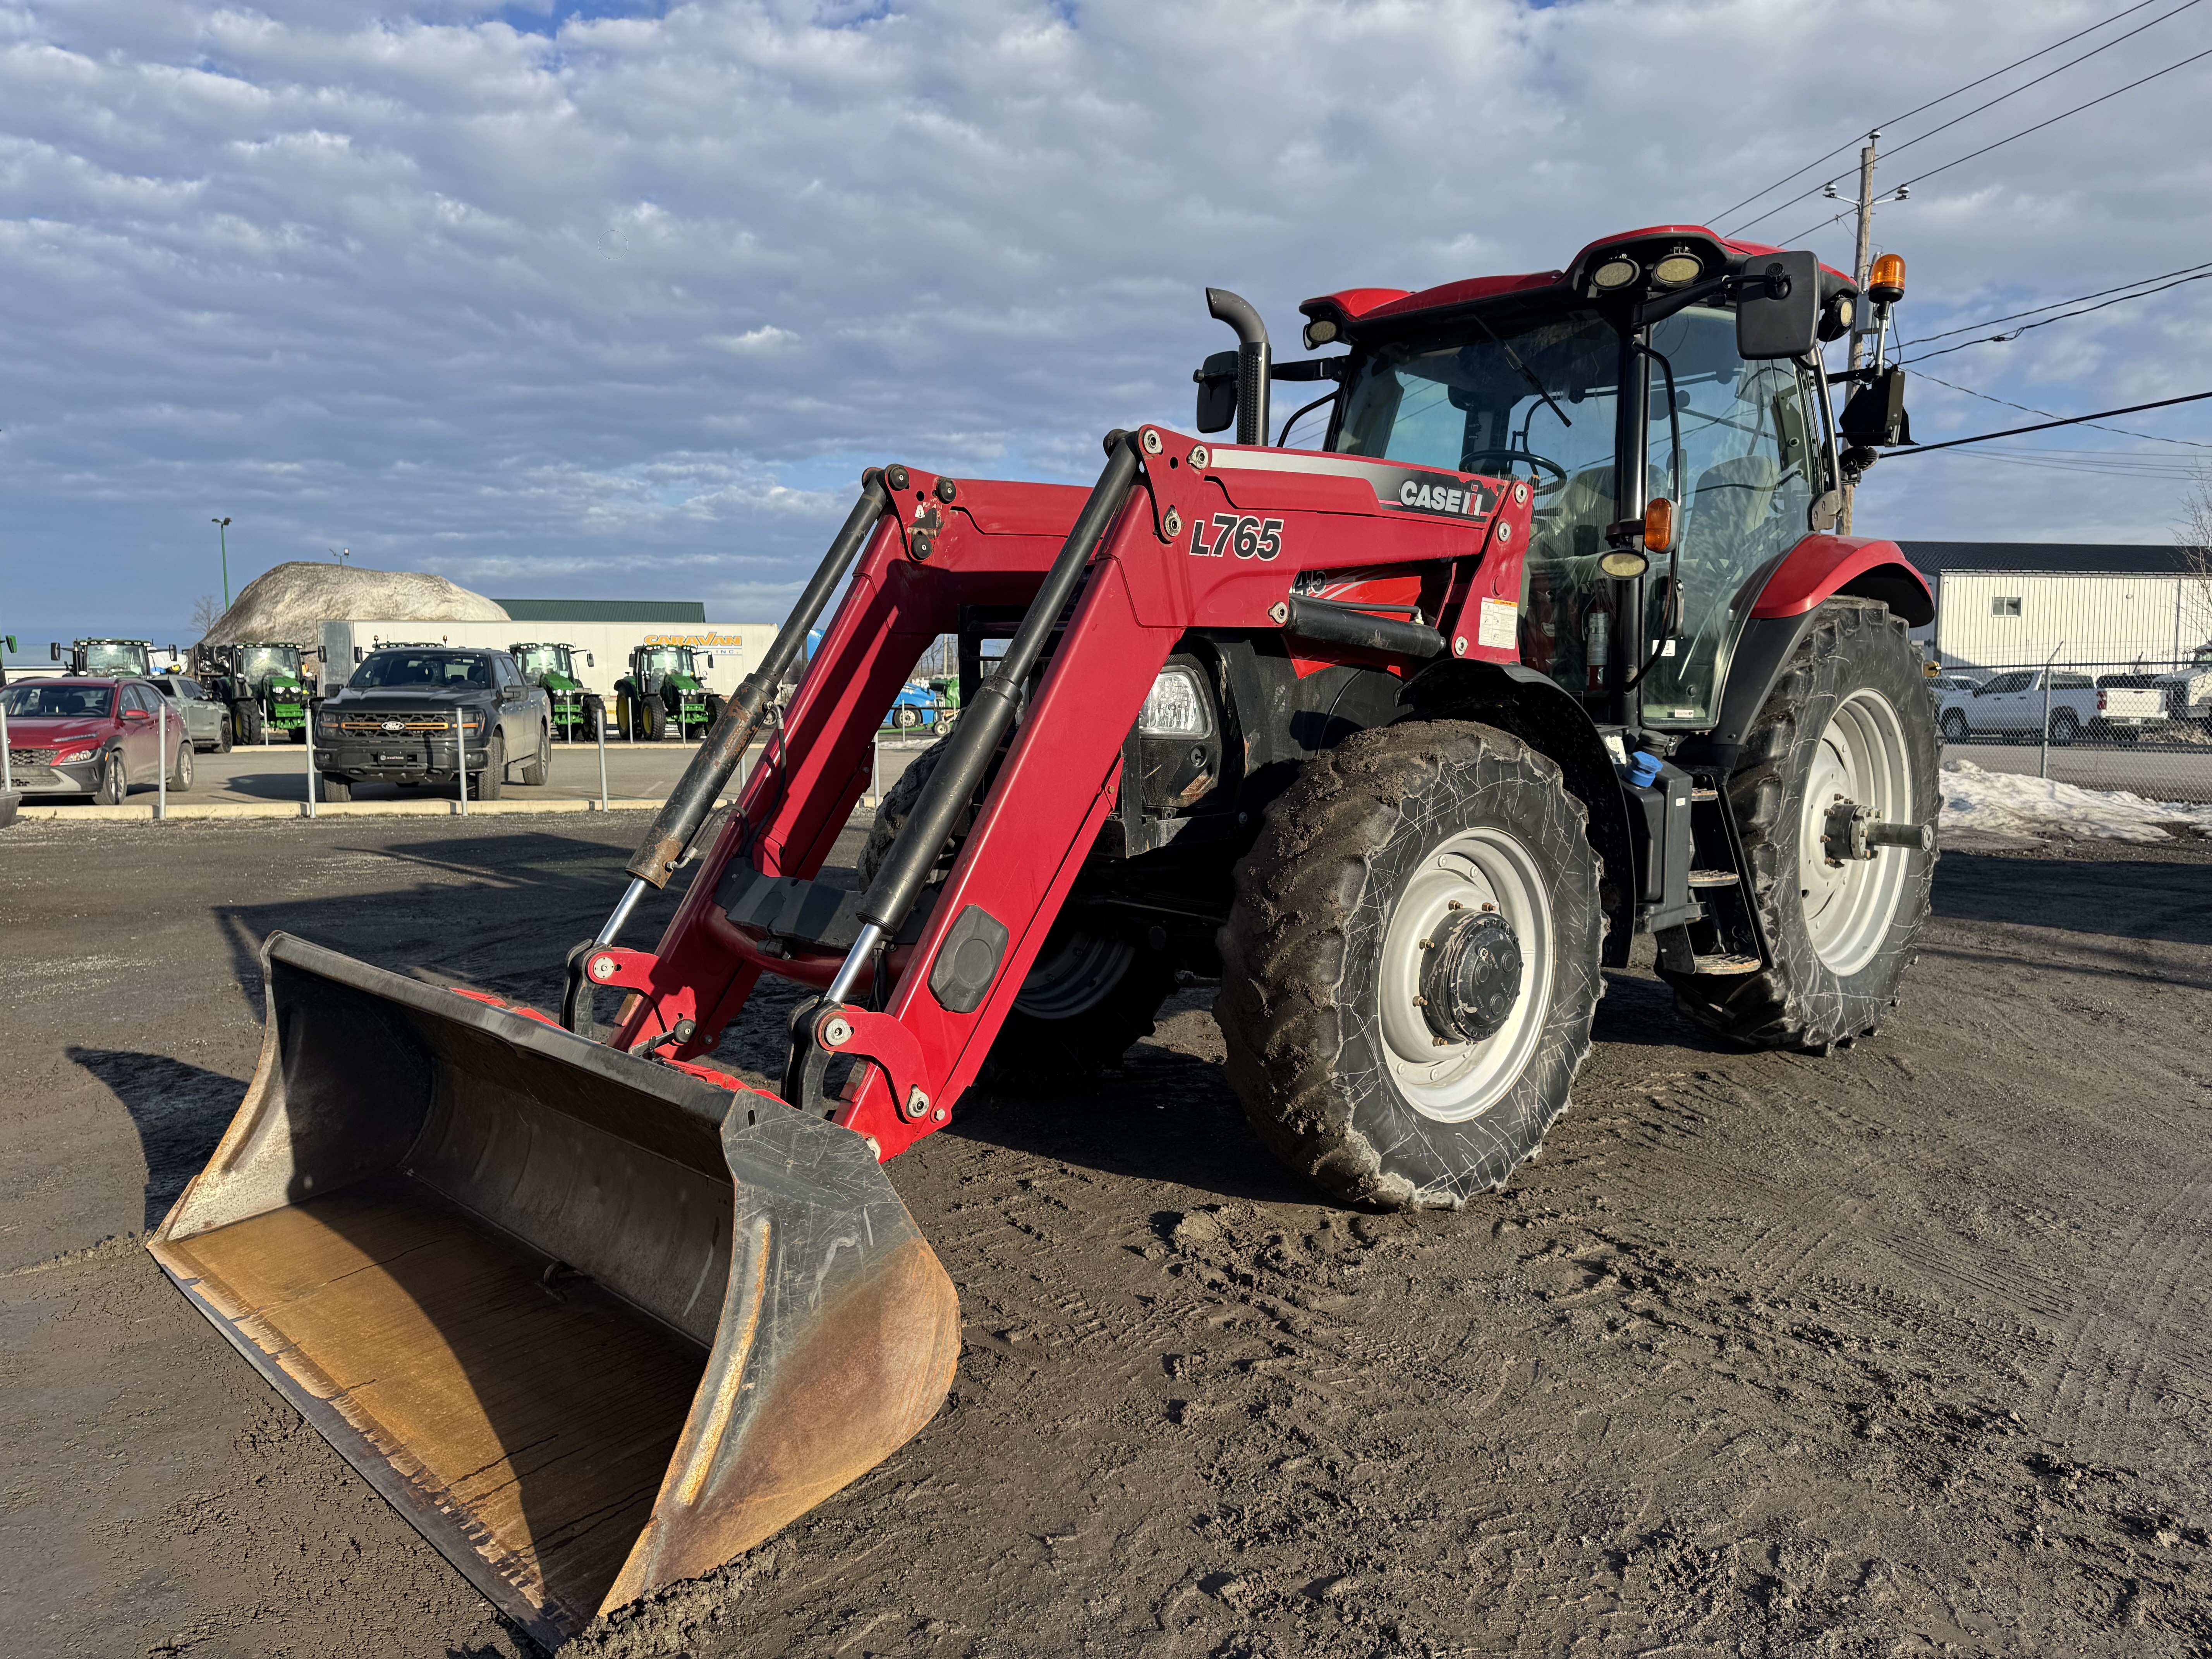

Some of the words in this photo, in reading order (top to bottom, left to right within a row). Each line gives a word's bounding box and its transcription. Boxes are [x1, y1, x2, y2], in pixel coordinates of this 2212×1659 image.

[1400, 481, 1462, 513] CASE
[1189, 512, 1285, 562] L765
[644, 632, 742, 646] CARAVAN
